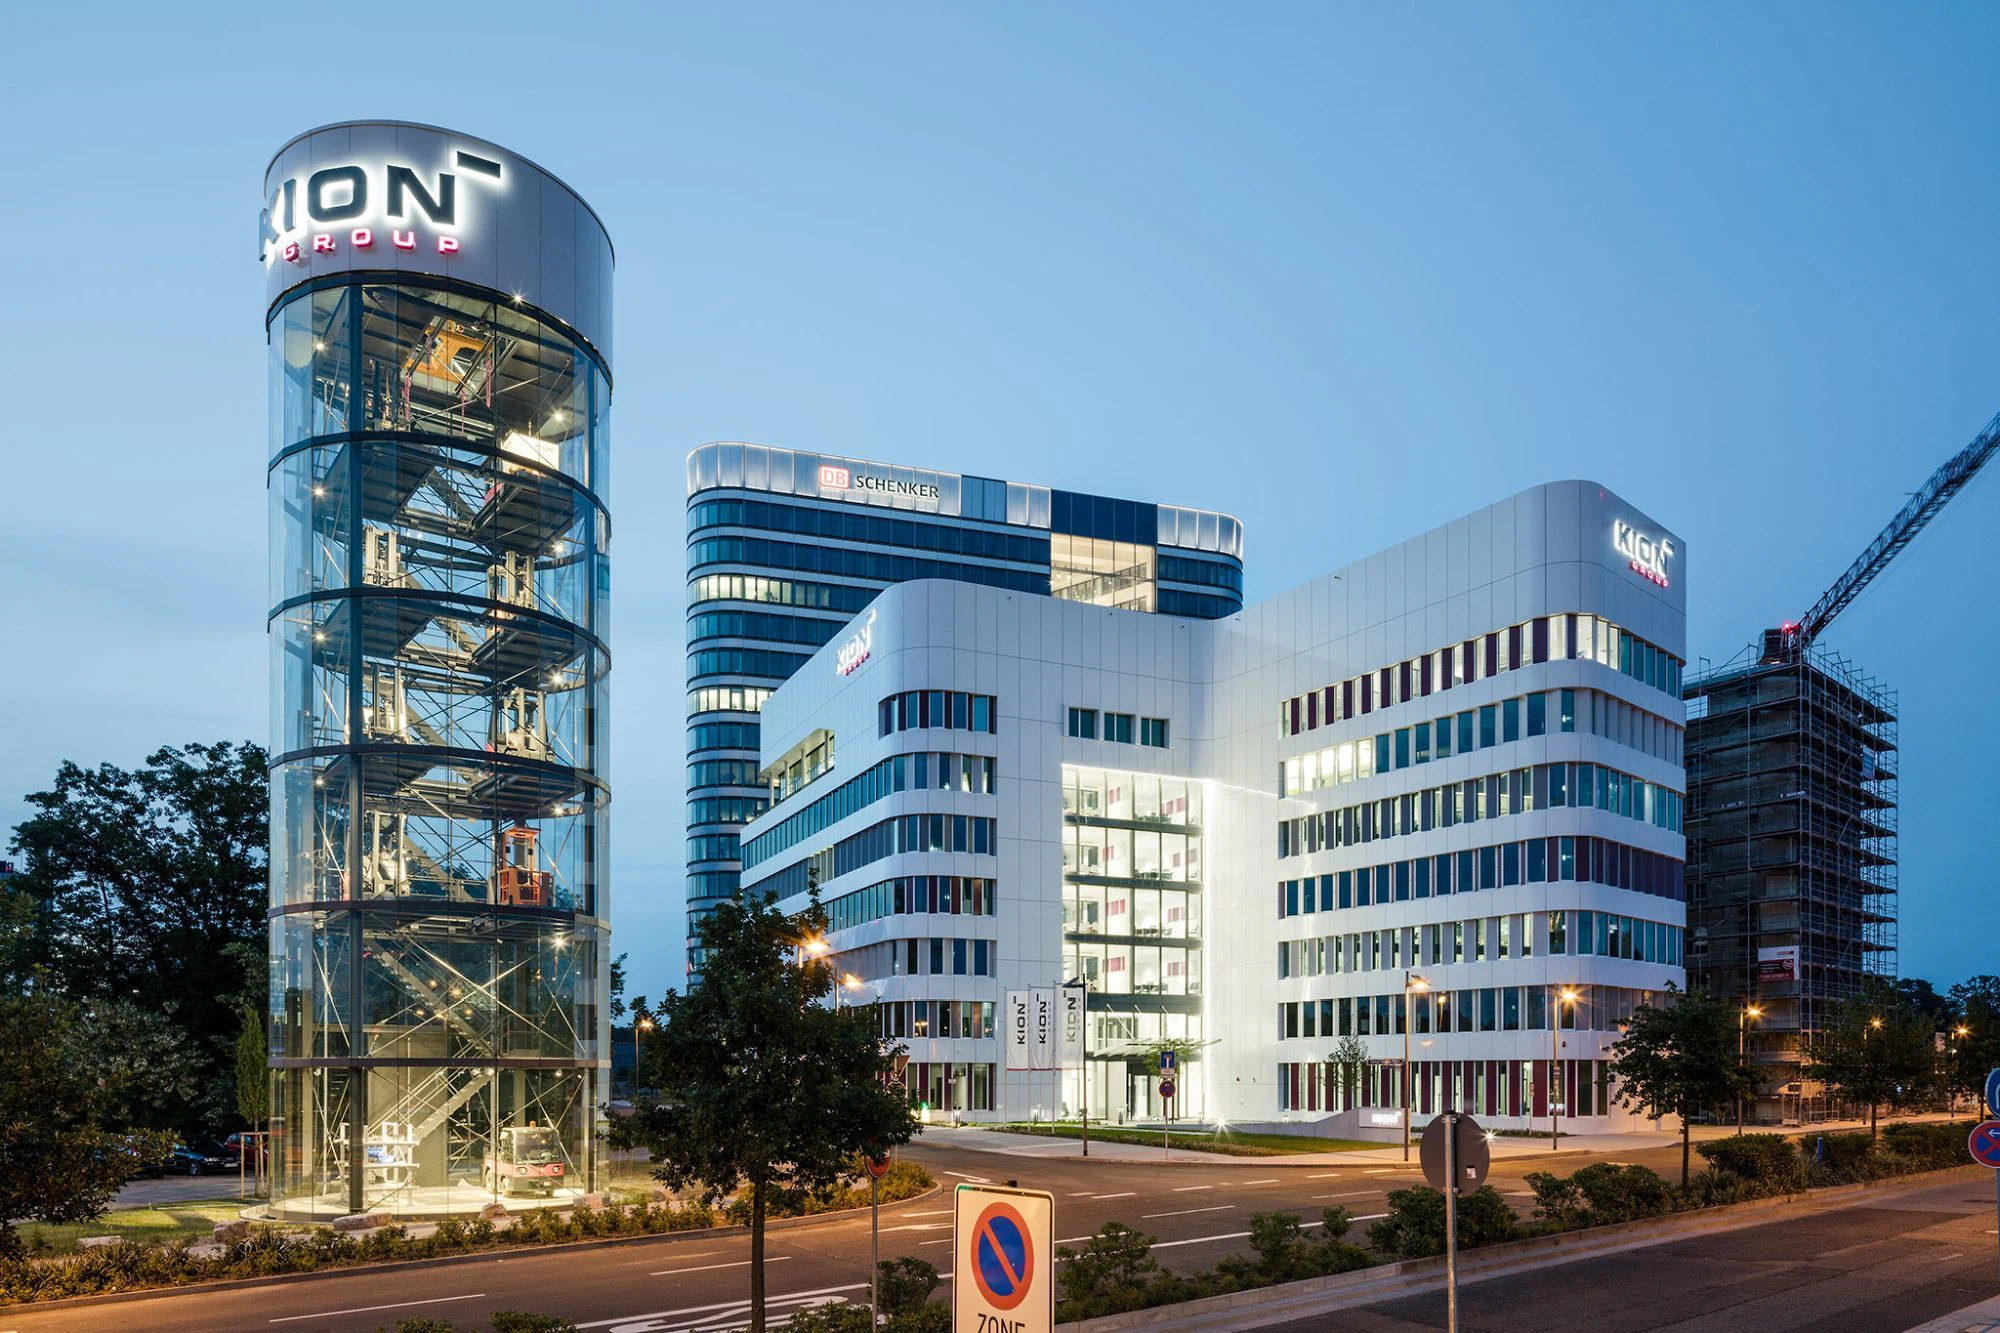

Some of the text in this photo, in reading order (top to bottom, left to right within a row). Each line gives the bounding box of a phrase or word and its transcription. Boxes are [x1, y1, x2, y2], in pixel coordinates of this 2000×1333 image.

[259, 164, 456, 262] KION
[283, 227, 459, 262] GROUP
[822, 469, 939, 498] DB SCHENKER
[1616, 521, 1668, 577] KION
[1630, 560, 1669, 588] GROUP
[1017, 1003, 1026, 1045] KION
[1039, 1001, 1047, 1044] KION
[1067, 997, 1077, 1043] KION
